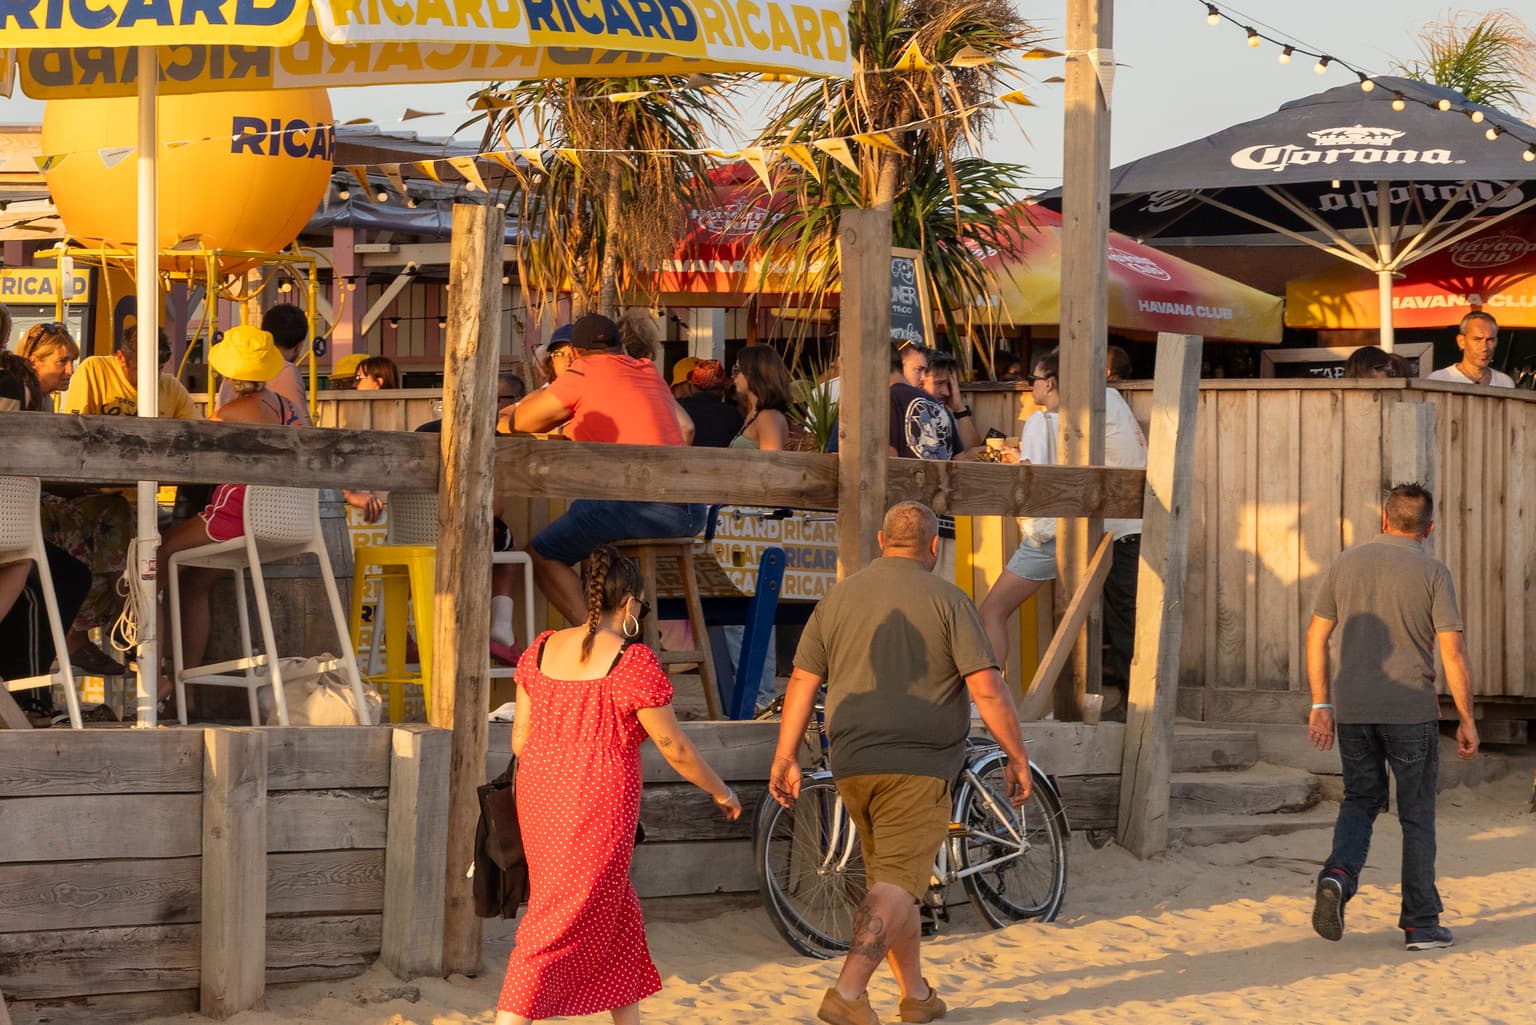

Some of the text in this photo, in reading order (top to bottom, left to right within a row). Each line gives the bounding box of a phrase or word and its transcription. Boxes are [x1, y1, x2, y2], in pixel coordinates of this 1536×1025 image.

[1230, 143, 1456, 173] Corona
[651, 258, 749, 273] AVANA
[1, 277, 87, 295] RICAD
[1138, 299, 1233, 320] HAVANA CLUB
[715, 515, 837, 542] RICARD RICAR
[784, 547, 837, 570] RICAR
